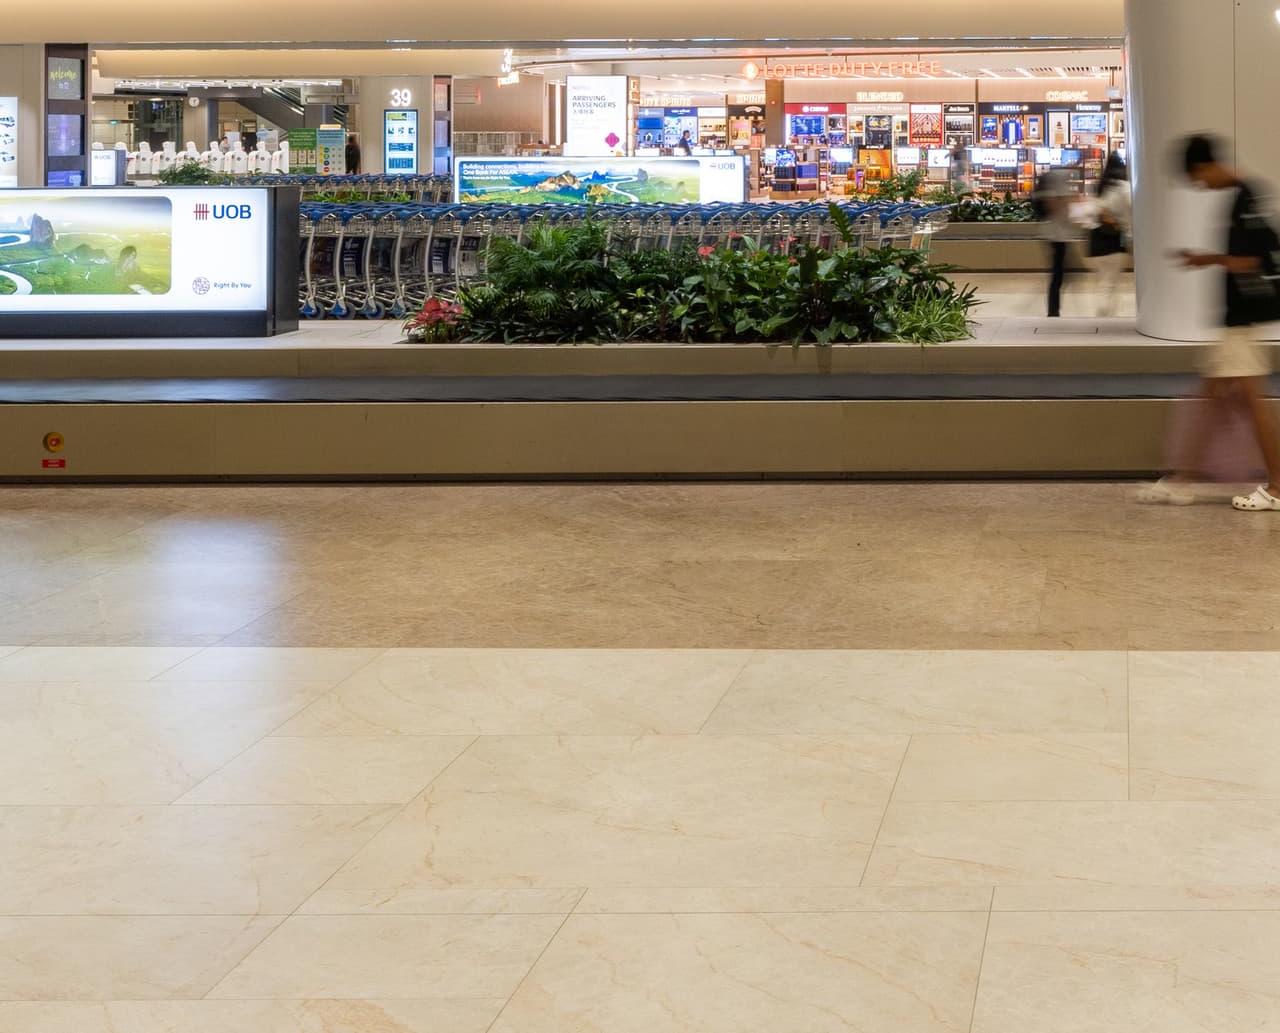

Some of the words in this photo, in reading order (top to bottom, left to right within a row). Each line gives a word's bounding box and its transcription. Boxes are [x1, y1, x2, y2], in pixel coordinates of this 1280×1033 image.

[763, 63, 825, 78] LOTTE
[829, 61, 883, 77] DUTY
[888, 60, 941, 76] FREE
[390, 88, 412, 107] 39
[572, 101, 617, 109] PASSENGERS
[993, 104, 1021, 112] MARTELL
[1075, 103, 1102, 112] Hennessy
[717, 162, 736, 170] UOB
[212, 204, 252, 219] UOB
